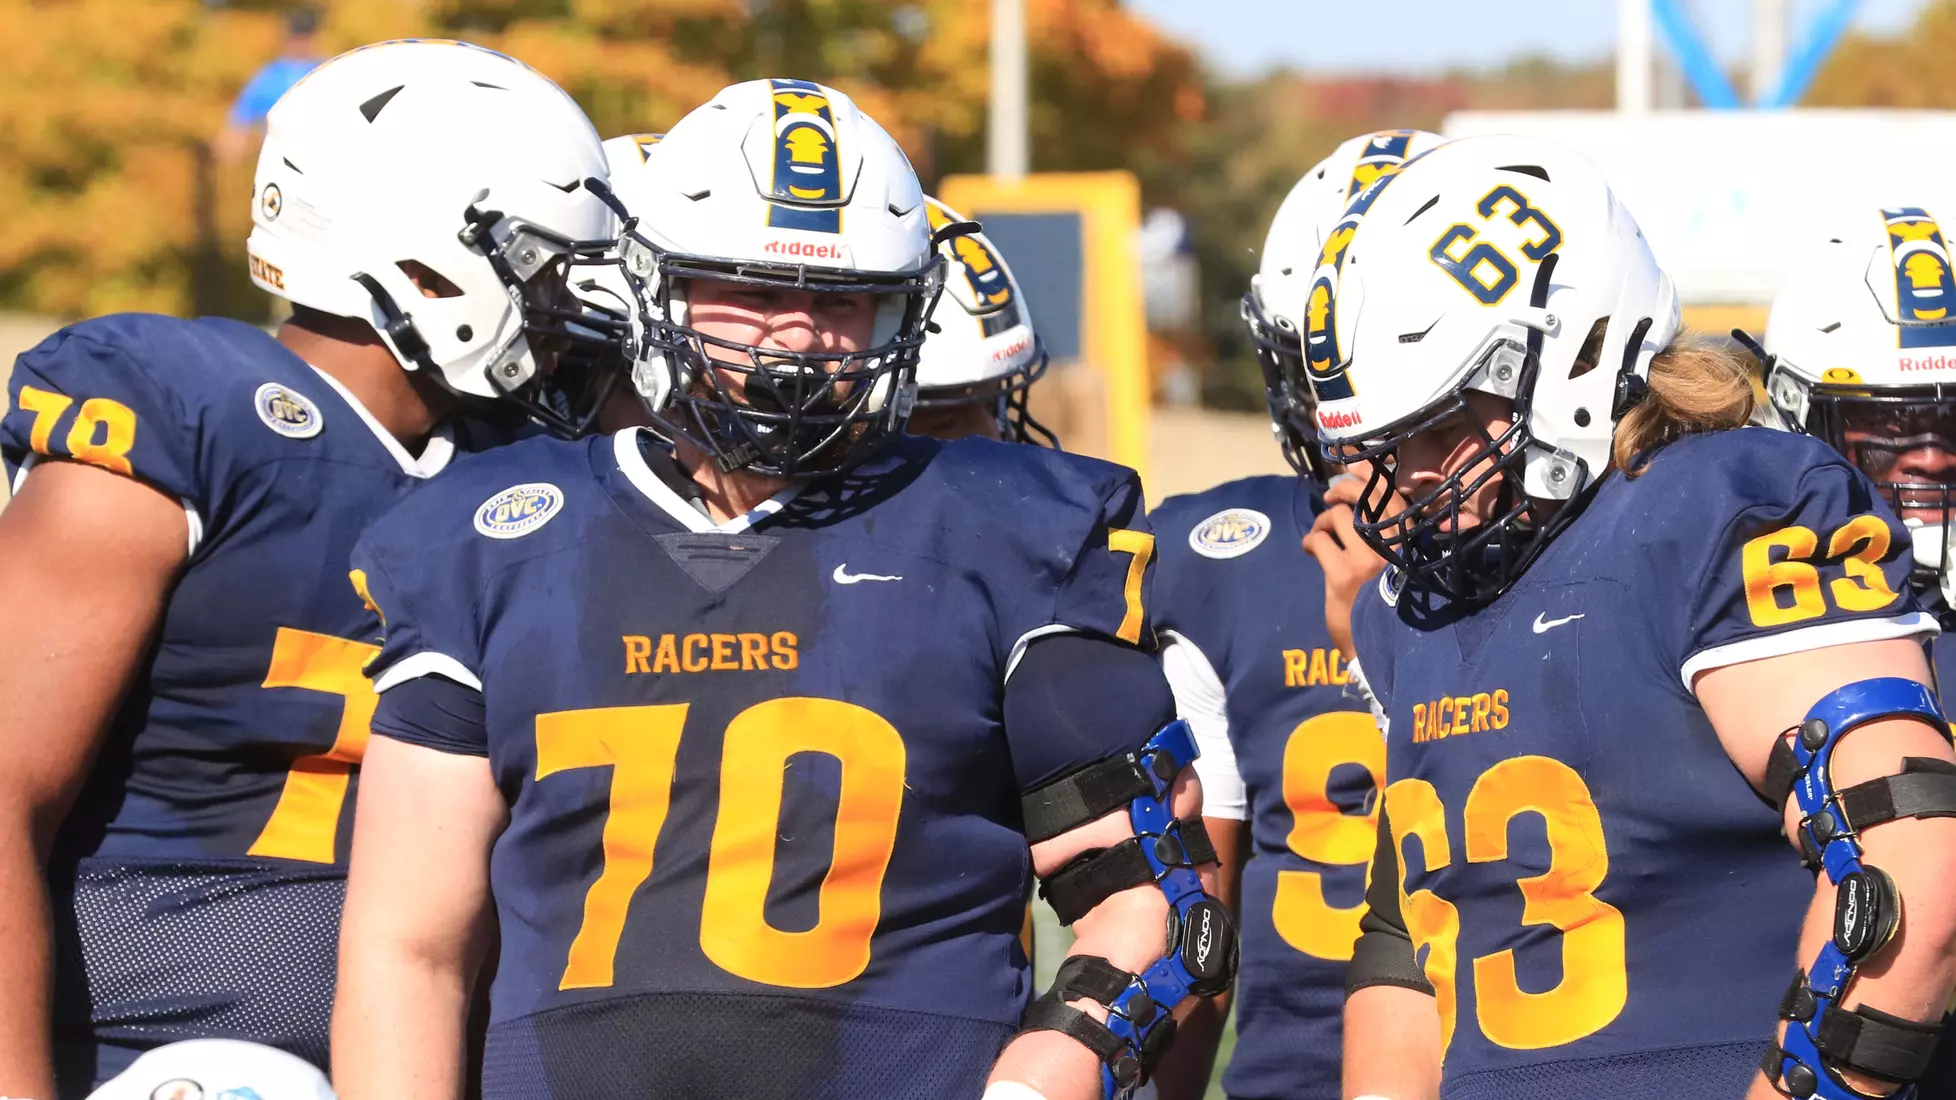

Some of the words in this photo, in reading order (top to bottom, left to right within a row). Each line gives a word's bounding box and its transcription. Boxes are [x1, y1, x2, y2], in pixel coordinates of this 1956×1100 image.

[1428, 184, 1564, 307] 63
[495, 496, 540, 523] OVC
[1108, 527, 1155, 645] 7
[1742, 515, 1900, 628] 63
[622, 631, 799, 674] RACERS
[1282, 648, 1355, 687] RAC
[246, 626, 383, 864] 7
[1412, 688, 1510, 744] RACERS
[534, 696, 907, 991] 70
[1272, 710, 1388, 961] 9
[1196, 907, 1212, 972] DONJOY
[1384, 755, 1628, 1068] 63
[1843, 879, 1857, 947] DONJOY
